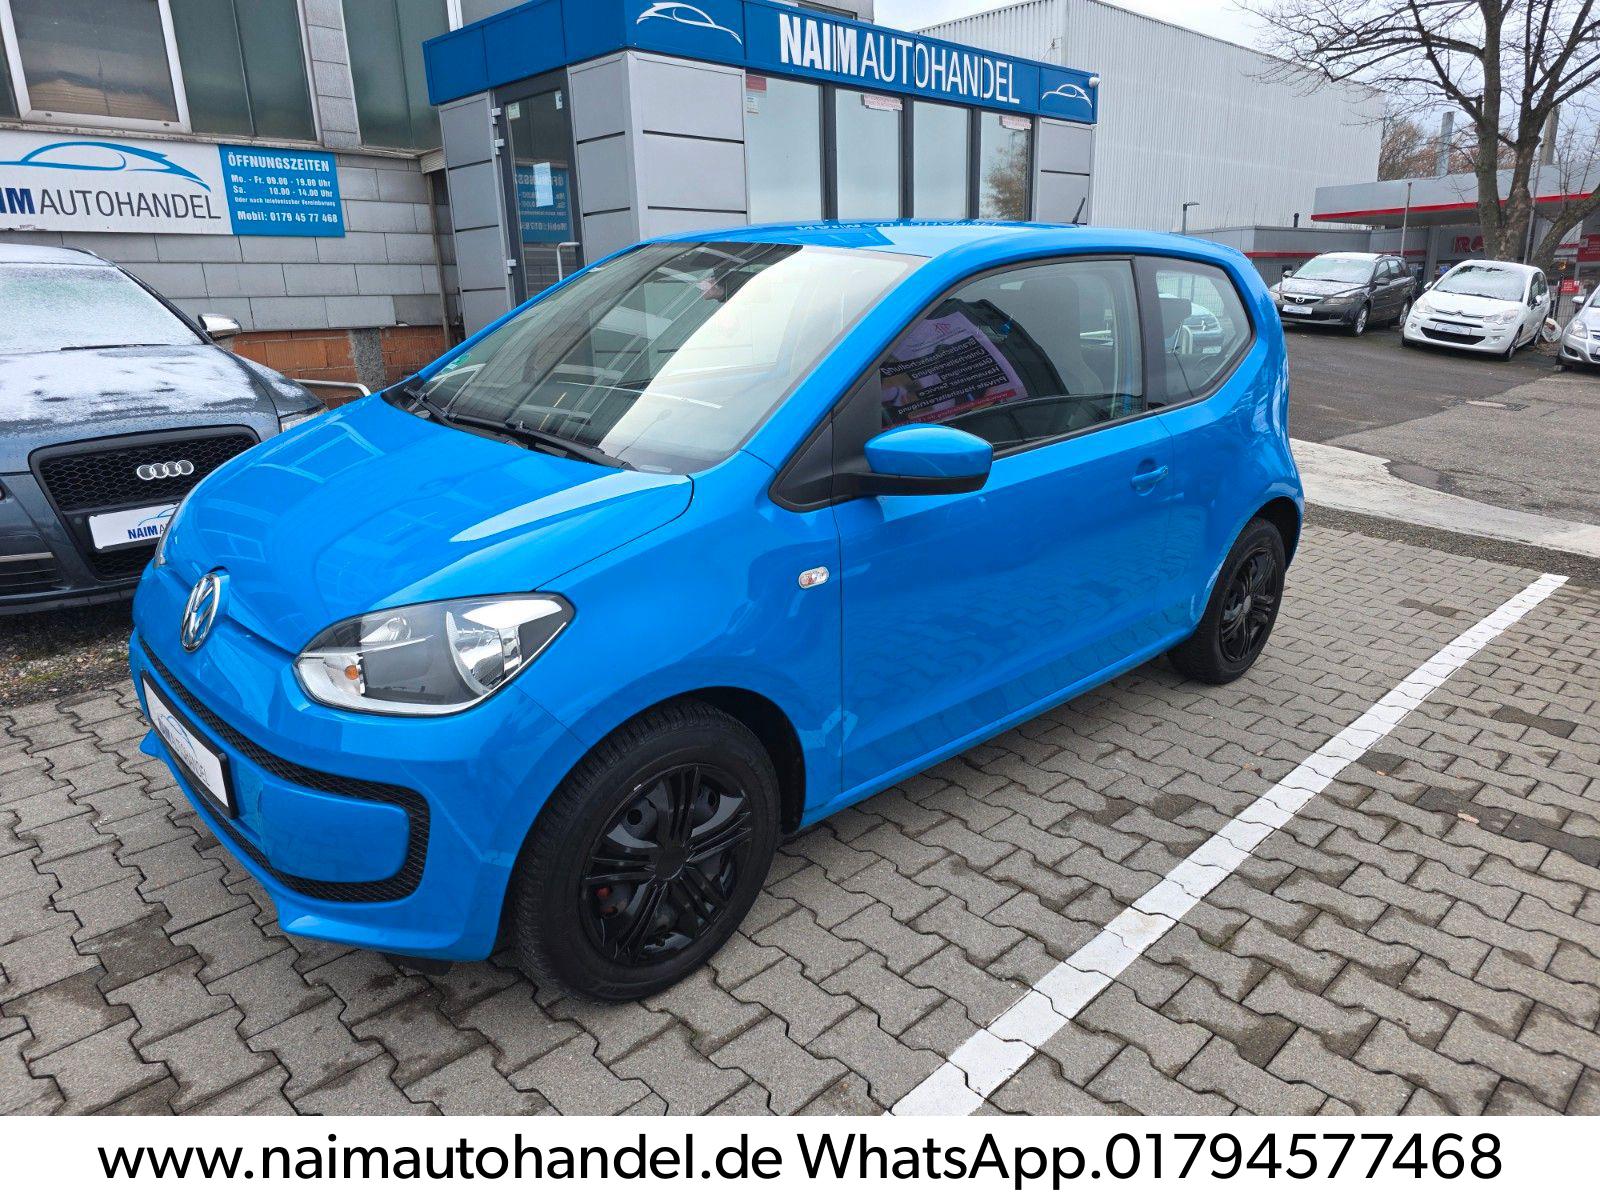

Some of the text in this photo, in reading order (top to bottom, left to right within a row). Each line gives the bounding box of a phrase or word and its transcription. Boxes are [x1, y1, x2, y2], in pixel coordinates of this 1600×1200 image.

[779, 13, 1020, 104] NAIM AUTOHANDEL
[228, 152, 330, 172] ÖFFNUNGSZEITEN
[231, 174, 247, 183] Mo.
[266, 176, 288, 186] 09.00
[296, 178, 317, 187] 19.00
[319, 179, 331, 188] Uhr
[233, 185, 247, 194] Sa.
[269, 187, 290, 196] 10.00
[298, 188, 318, 197] 14.00
[320, 189, 333, 198] Uhr
[40, 188, 222, 219] AUTOHANDEL
[237, 210, 338, 223] Mobil: 0179 45 77 468
[127, 525, 158, 539] NAIM
